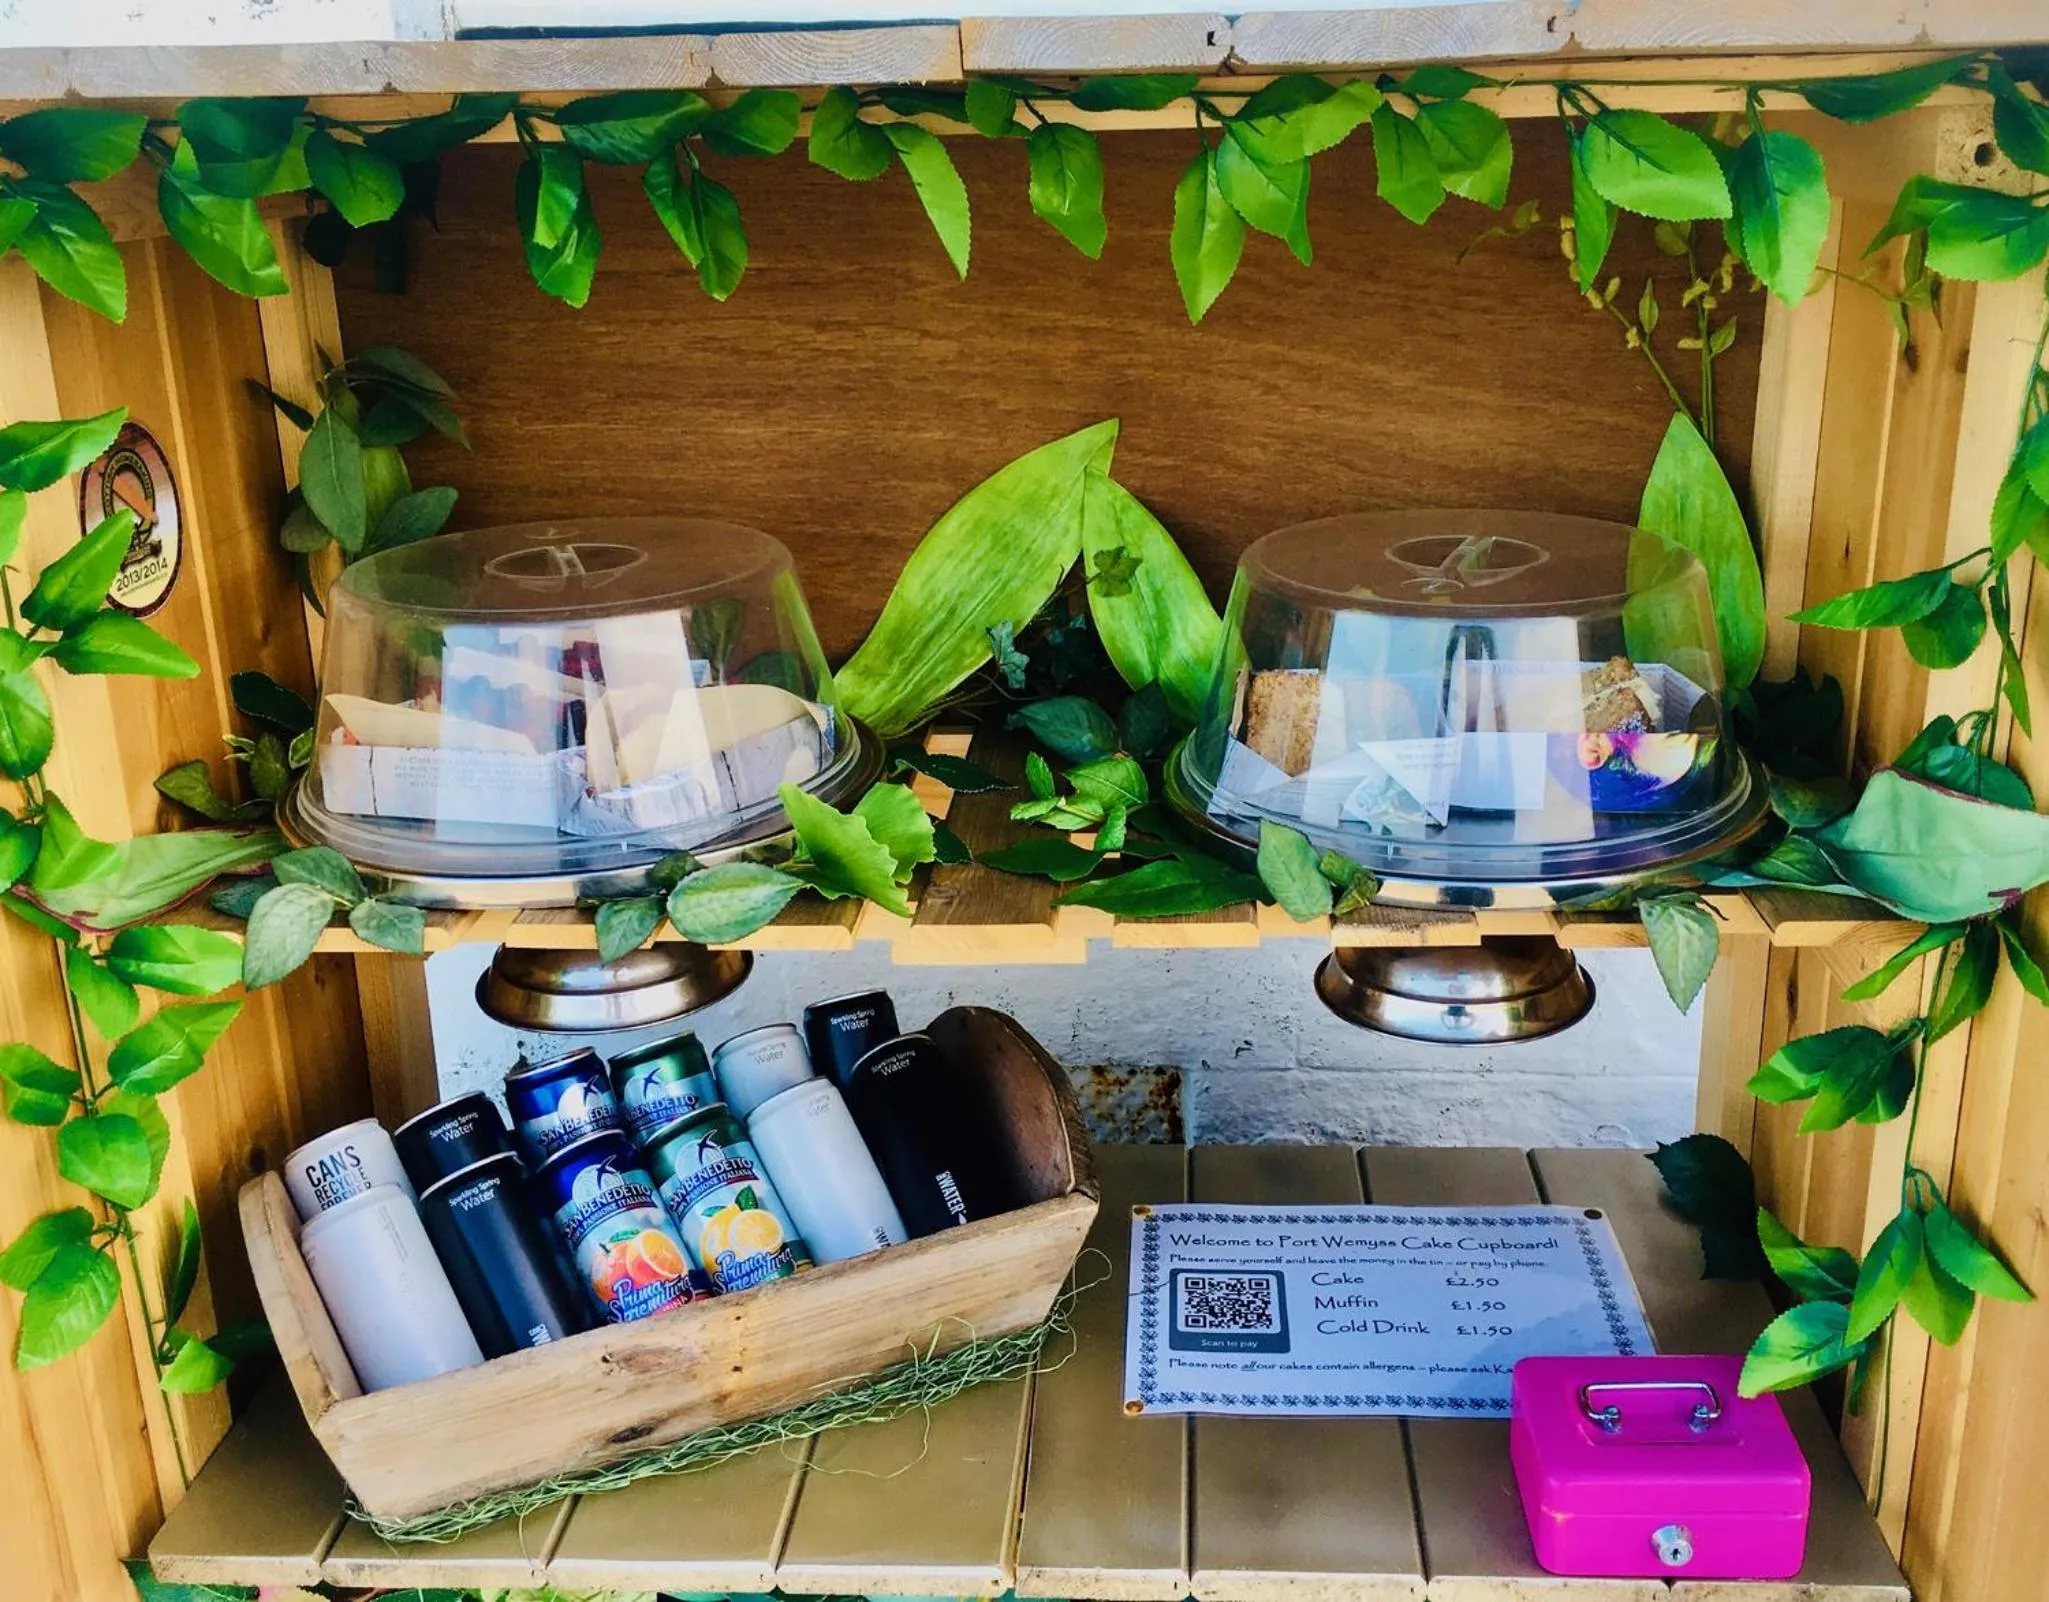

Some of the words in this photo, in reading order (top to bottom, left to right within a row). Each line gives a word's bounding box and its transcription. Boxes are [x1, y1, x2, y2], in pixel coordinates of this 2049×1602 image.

[116, 557, 168, 592] 2013/2014
[840, 1019, 869, 1032] Water
[754, 1050, 784, 1065] Water
[881, 1059, 910, 1076] Water
[429, 1119, 459, 1139] Sparkling
[440, 1123, 473, 1142] Water
[540, 1124, 564, 1145] SAN
[305, 1145, 361, 1188] CANS
[684, 1158, 752, 1190] BENEDETTO
[448, 1186, 479, 1207] Sparkling
[478, 1177, 500, 1190] Spring
[460, 1188, 495, 1211] Water
[938, 1176, 966, 1215] WATER
[564, 1213, 581, 1238] SAN
[581, 1184, 651, 1217] BENEDETTO
[1170, 1234, 1251, 1247] Welcome
[1256, 1237, 1274, 1247] to
[1278, 1235, 1318, 1248] Port
[1321, 1235, 1397, 1250] Wemyss
[1401, 1236, 1453, 1250] Cake
[1458, 1237, 1559, 1253] Cupboard!
[1170, 1253, 1206, 1263] Please
[1240, 1256, 1284, 1266] yourself
[1286, 1256, 1306, 1264] and
[1308, 1256, 1336, 1265] leave
[1339, 1256, 1357, 1265] the
[1358, 1258, 1395, 1266] money
[1397, 1257, 1407, 1265] in
[1409, 1257, 1427, 1266] the
[1430, 1258, 1443, 1266] tin
[1471, 1260, 1492, 1269] pay
[1493, 1260, 1508, 1270] by
[1311, 1272, 1364, 1286] Cake
[1446, 1277, 1500, 1289] £2.50
[612, 1278, 661, 1310] Prima
[1314, 1295, 1379, 1310] Muffin
[1451, 1301, 1506, 1312] £1.50
[1316, 1320, 1368, 1334] Cold
[1373, 1320, 1431, 1334] Drink
[1456, 1325, 1513, 1337] £1.50
[1201, 1339, 1225, 1347] Scan
[1240, 1340, 1258, 1349] pay
[1169, 1358, 1208, 1369] Please
[1241, 1360, 1258, 1371] all
[1279, 1361, 1313, 1370] cakes
[1316, 1362, 1361, 1370] contain
[1363, 1361, 1416, 1372] allergens
[1429, 1364, 1468, 1375] please
[1470, 1366, 1491, 1374] ask
[1494, 1364, 1514, 1375] Ka
